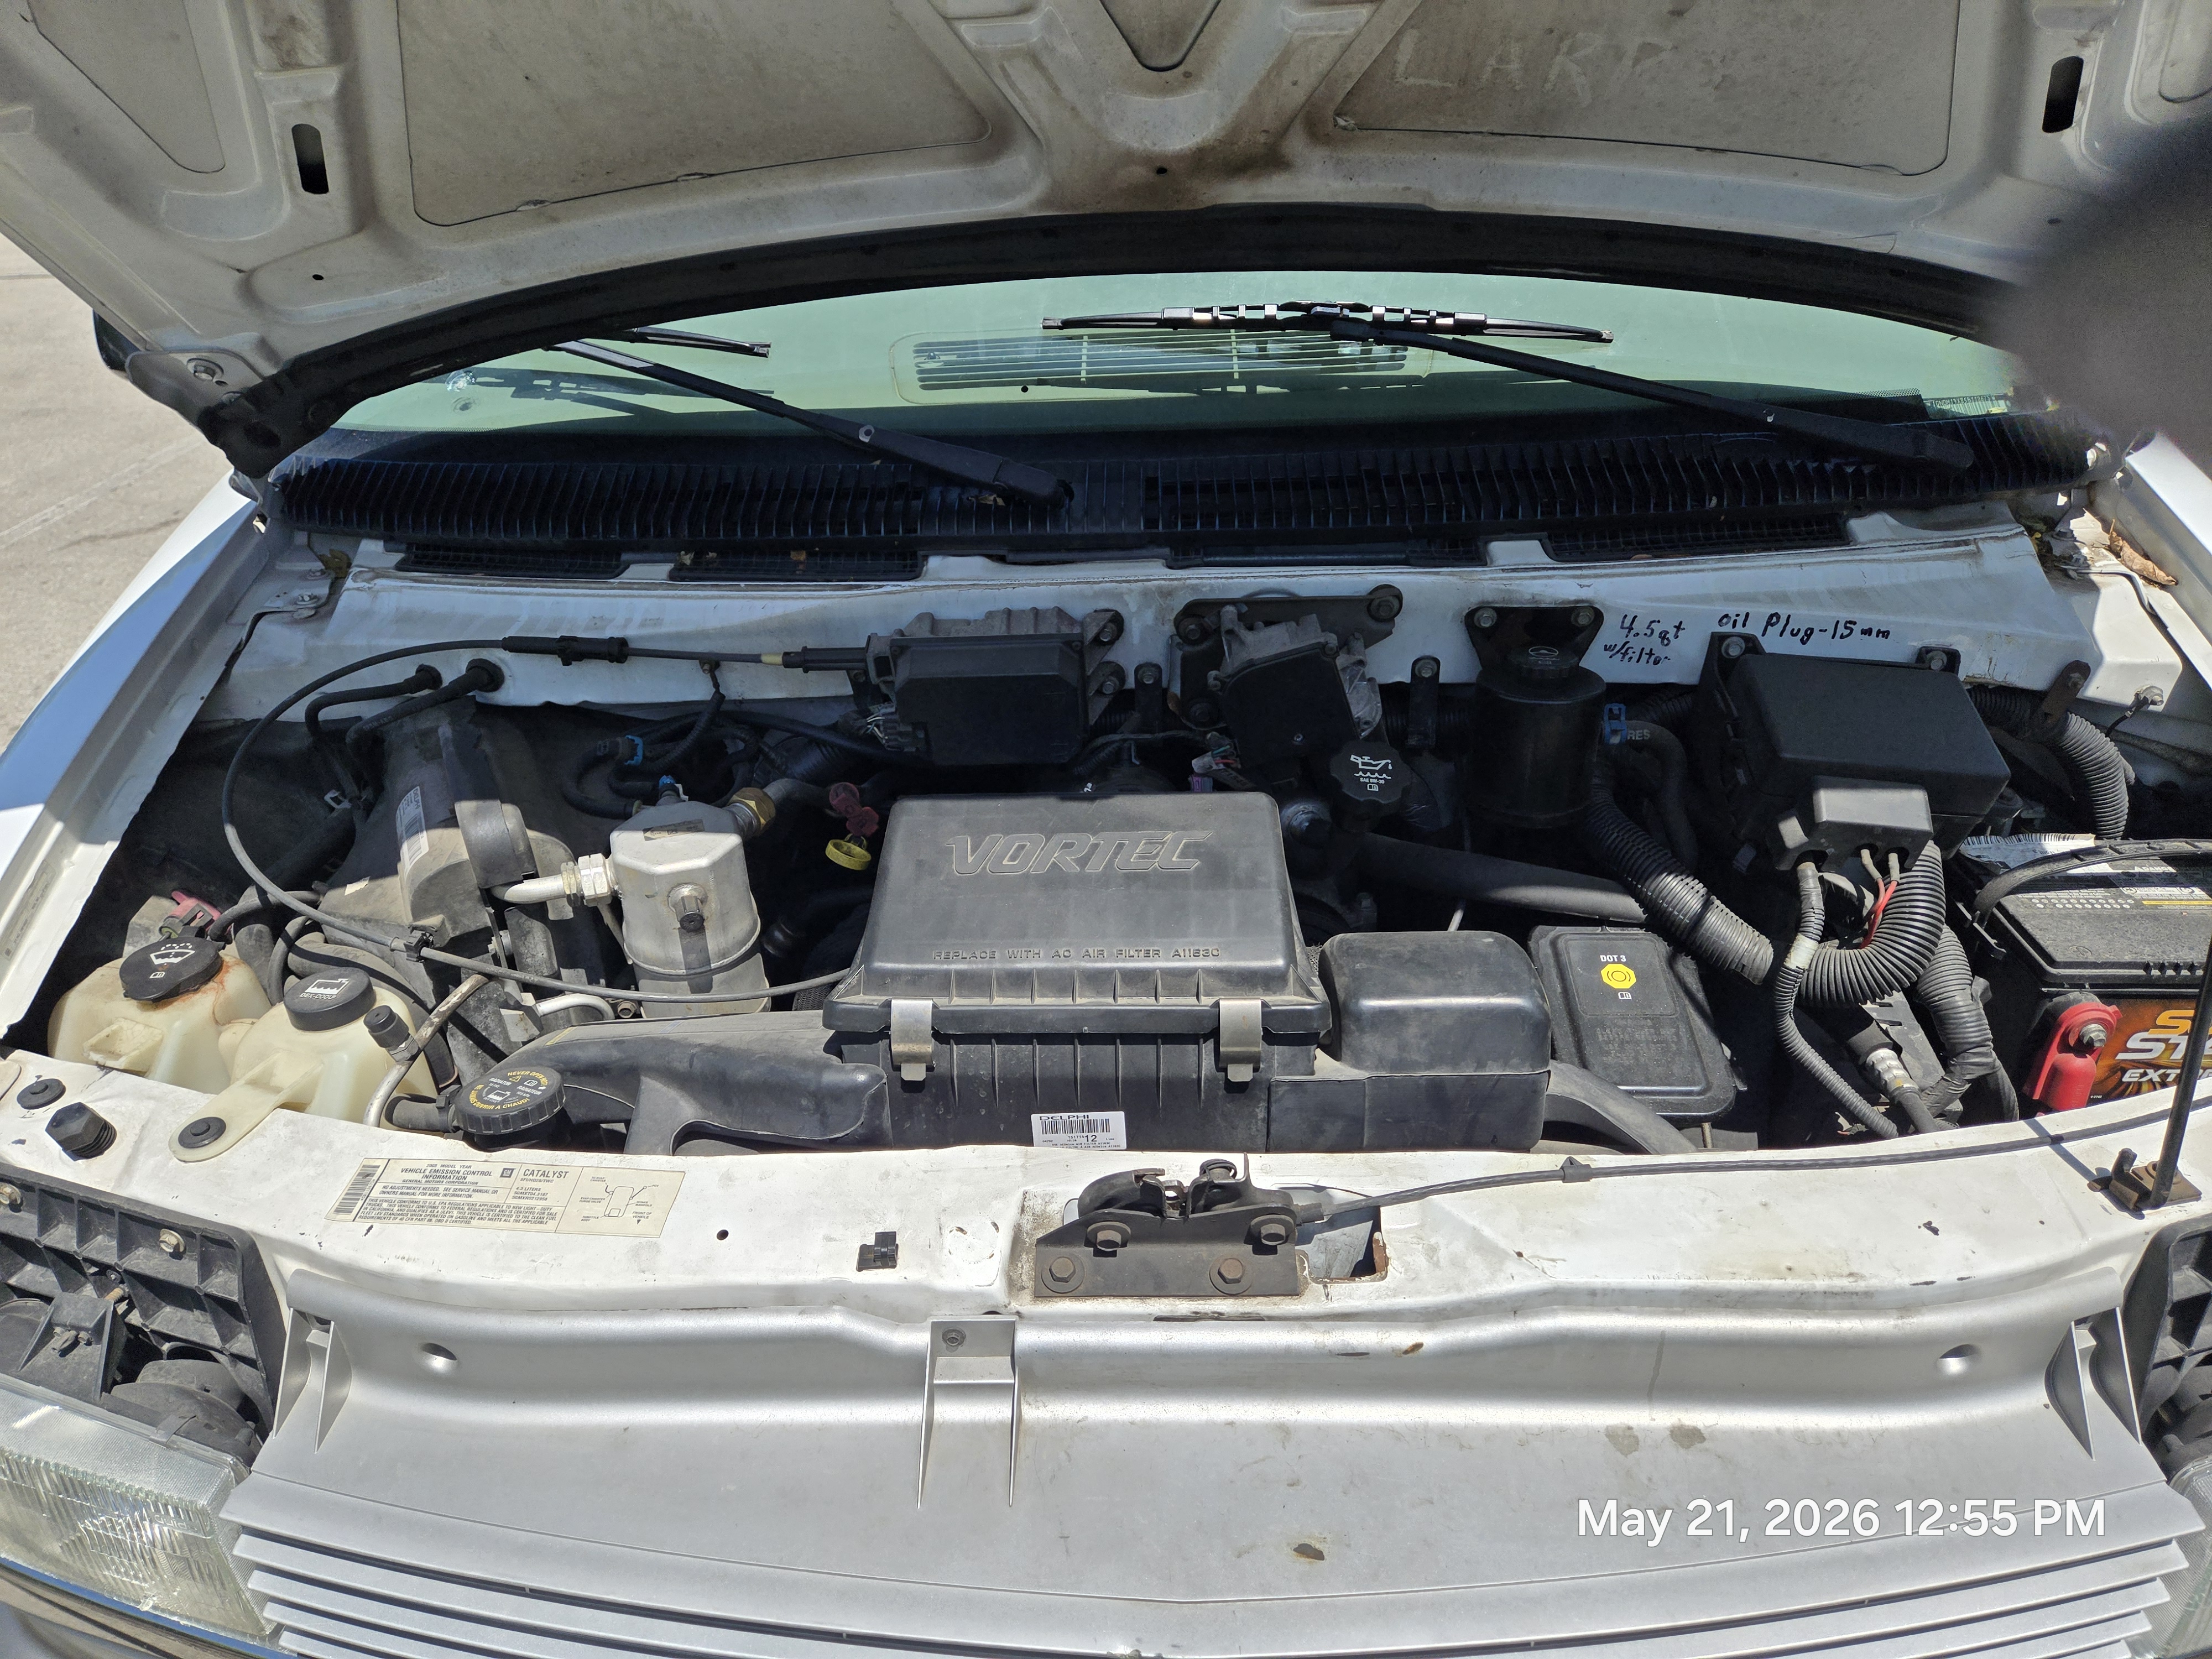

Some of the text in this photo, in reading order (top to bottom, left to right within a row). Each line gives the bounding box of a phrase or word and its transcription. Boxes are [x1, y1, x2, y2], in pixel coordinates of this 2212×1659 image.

[946, 830, 1213, 875] VORTEC
[933, 950, 996, 961] REPLACE
[1007, 948, 1041, 959] WITH
[1052, 948, 1072, 959] AC
[1082, 948, 1105, 958] AIR
[1115, 948, 1161, 958] FILTER
[488, 1077, 512, 1086] RADIATOR
[517, 1086, 542, 1095] RADIATEUR
[473, 1100, 494, 1109] OUVRIR
[523, 1168, 569, 1178] CATALYST
